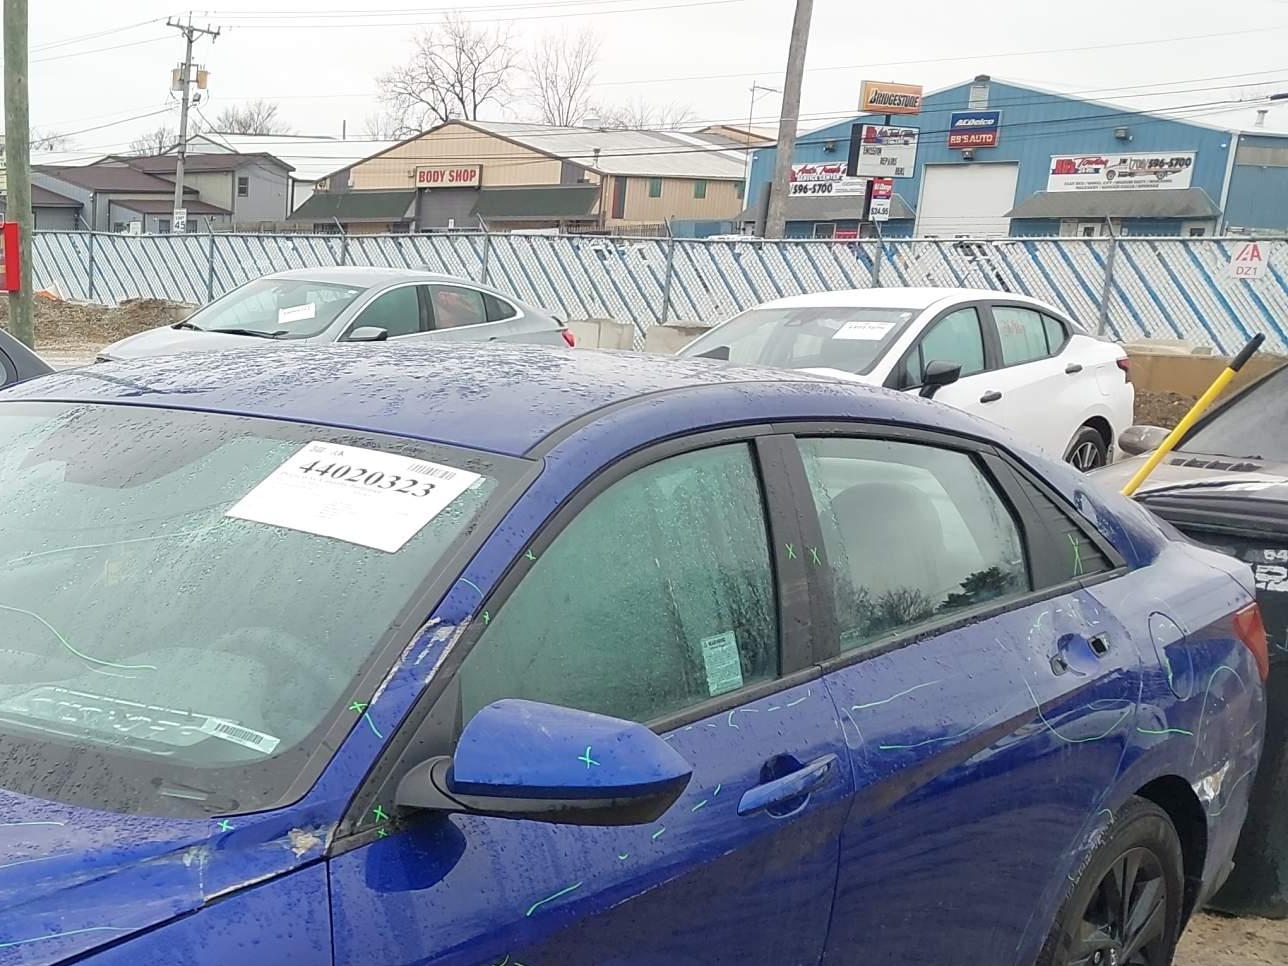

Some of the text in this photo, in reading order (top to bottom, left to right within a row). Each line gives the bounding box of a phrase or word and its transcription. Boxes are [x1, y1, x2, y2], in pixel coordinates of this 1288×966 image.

[869, 89, 920, 108] BRIDGESTONE
[969, 134, 993, 143] AUTO
[1147, 157, 1192, 169] 596-5700
[418, 169, 476, 183] BODY SHOP
[794, 184, 833, 194] 596-5700
[174, 221, 186, 232] 45
[1236, 266, 1257, 276] DZ1
[299, 459, 436, 499] 44020323
